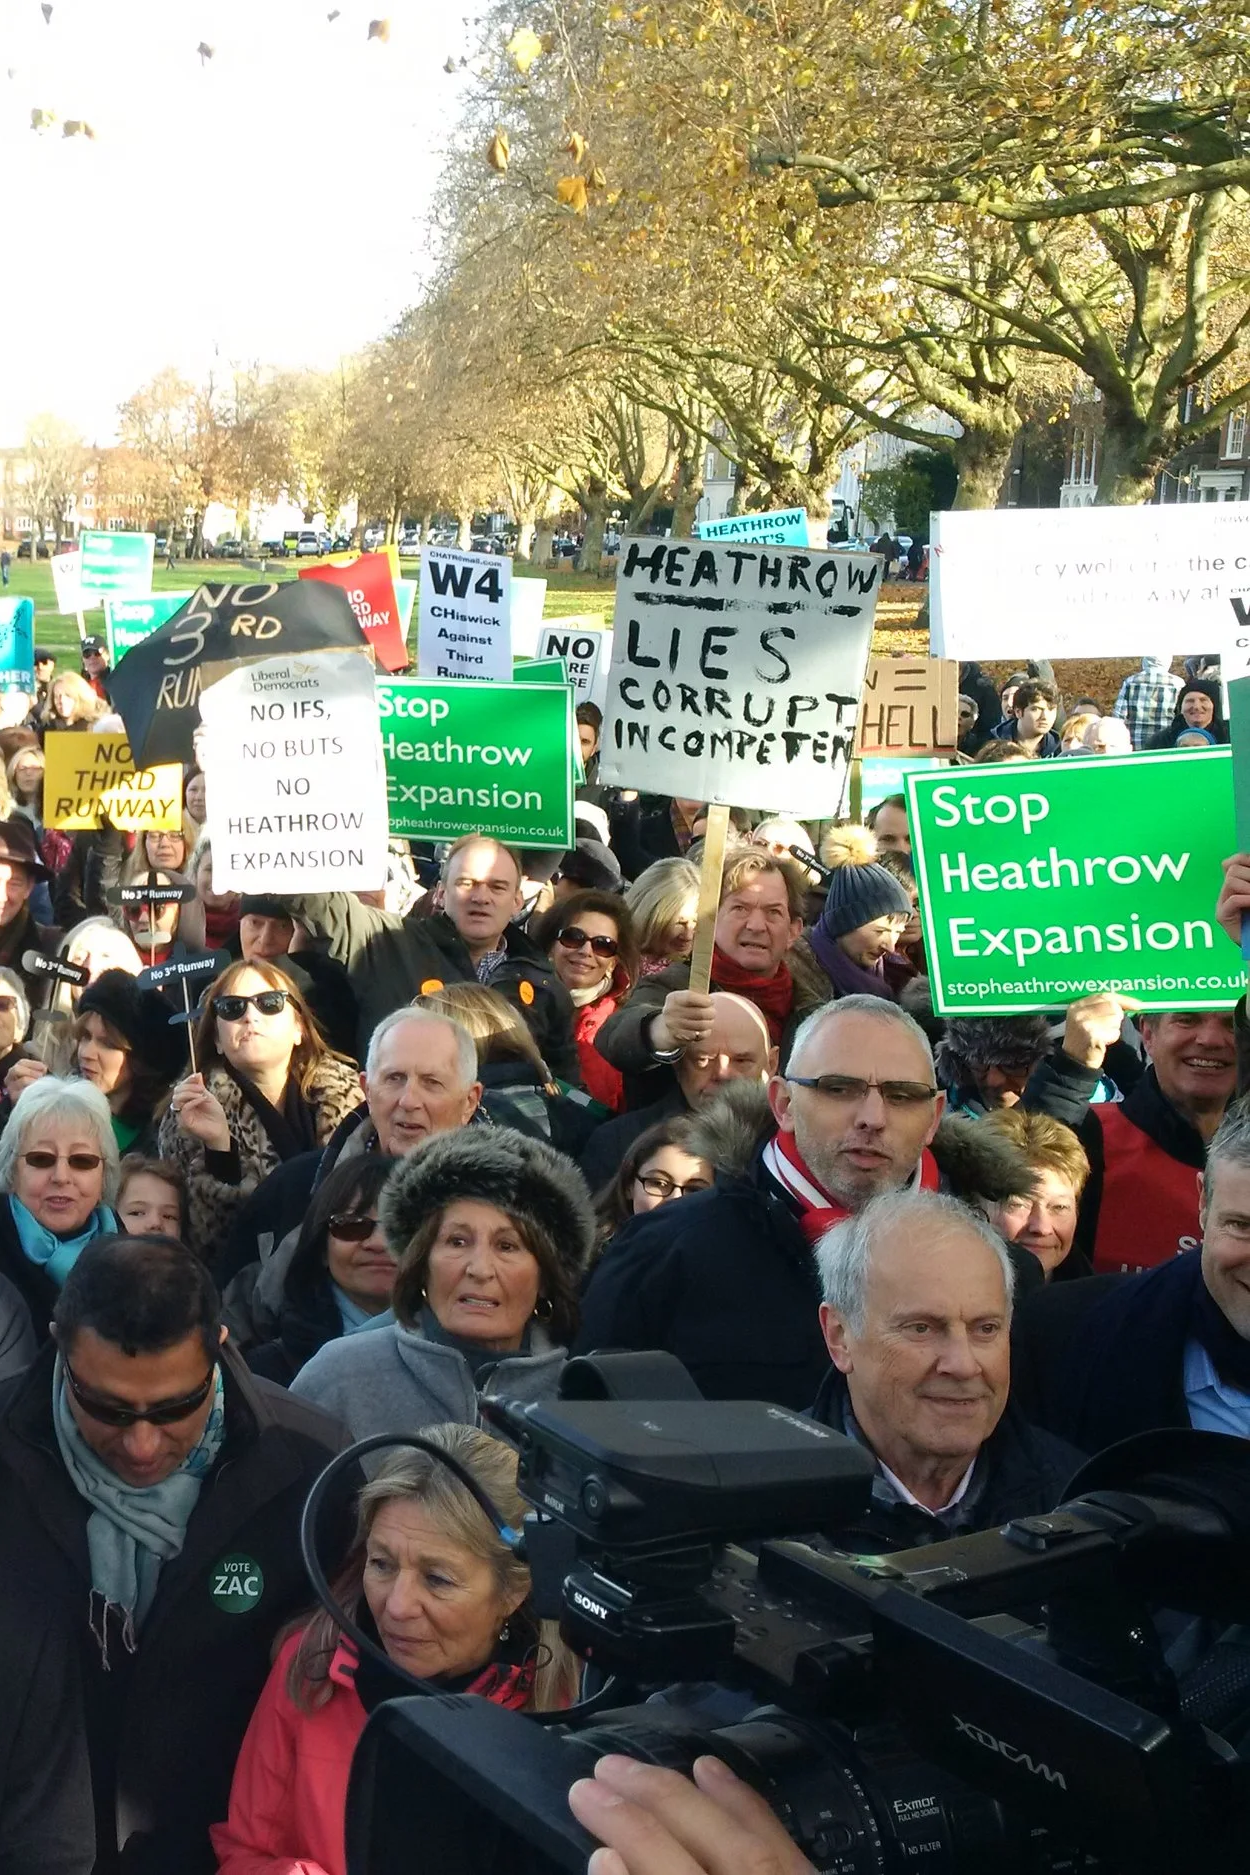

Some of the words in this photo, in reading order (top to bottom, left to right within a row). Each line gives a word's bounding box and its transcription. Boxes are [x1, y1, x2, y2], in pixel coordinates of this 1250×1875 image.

[706, 513, 801, 538] HEATHROW
[428, 560, 503, 604] W4
[623, 544, 877, 597] HEATHROW
[187, 583, 279, 615] NO
[430, 606, 500, 626] CHiswick
[163, 612, 212, 666] 3
[231, 614, 283, 640] RD
[438, 628, 492, 645] Against
[546, 635, 595, 659] NO
[446, 649, 483, 664] Third
[627, 620, 796, 684] LIES
[251, 669, 290, 682] Liberal
[253, 678, 320, 692] Democrats
[251, 702, 285, 721] NO
[293, 700, 331, 720] IFS,
[376, 687, 449, 726] Stop
[619, 677, 859, 728] CORRUPT
[863, 704, 954, 749] HELL
[95, 743, 133, 764] NO
[243, 741, 275, 759] NO
[285, 736, 343, 757] BUTS
[382, 732, 533, 766] Heathrow
[75, 770, 155, 791] THIRD
[276, 777, 310, 796] NO
[386, 775, 542, 811] Expansion
[54, 798, 175, 820] RUNWAY
[932, 786, 1049, 835] Stop
[228, 811, 364, 834] HEATHROW
[231, 848, 364, 870] EXPANSION
[940, 847, 1190, 893] Heathrow
[122, 890, 135, 899] No
[136, 890, 148, 899] 3rd
[149, 890, 183, 899] Runway
[949, 913, 1213, 967] Expansion
[35, 957, 47, 969] No
[151, 971, 163, 981] No
[164, 965, 177, 977] 3rd
[178, 958, 215, 973] Runway
[224, 1563, 250, 1572] VOTE
[213, 1576, 258, 1596] ZAC
[574, 1591, 607, 1619] SONY
[893, 1796, 936, 1814] Exmor
